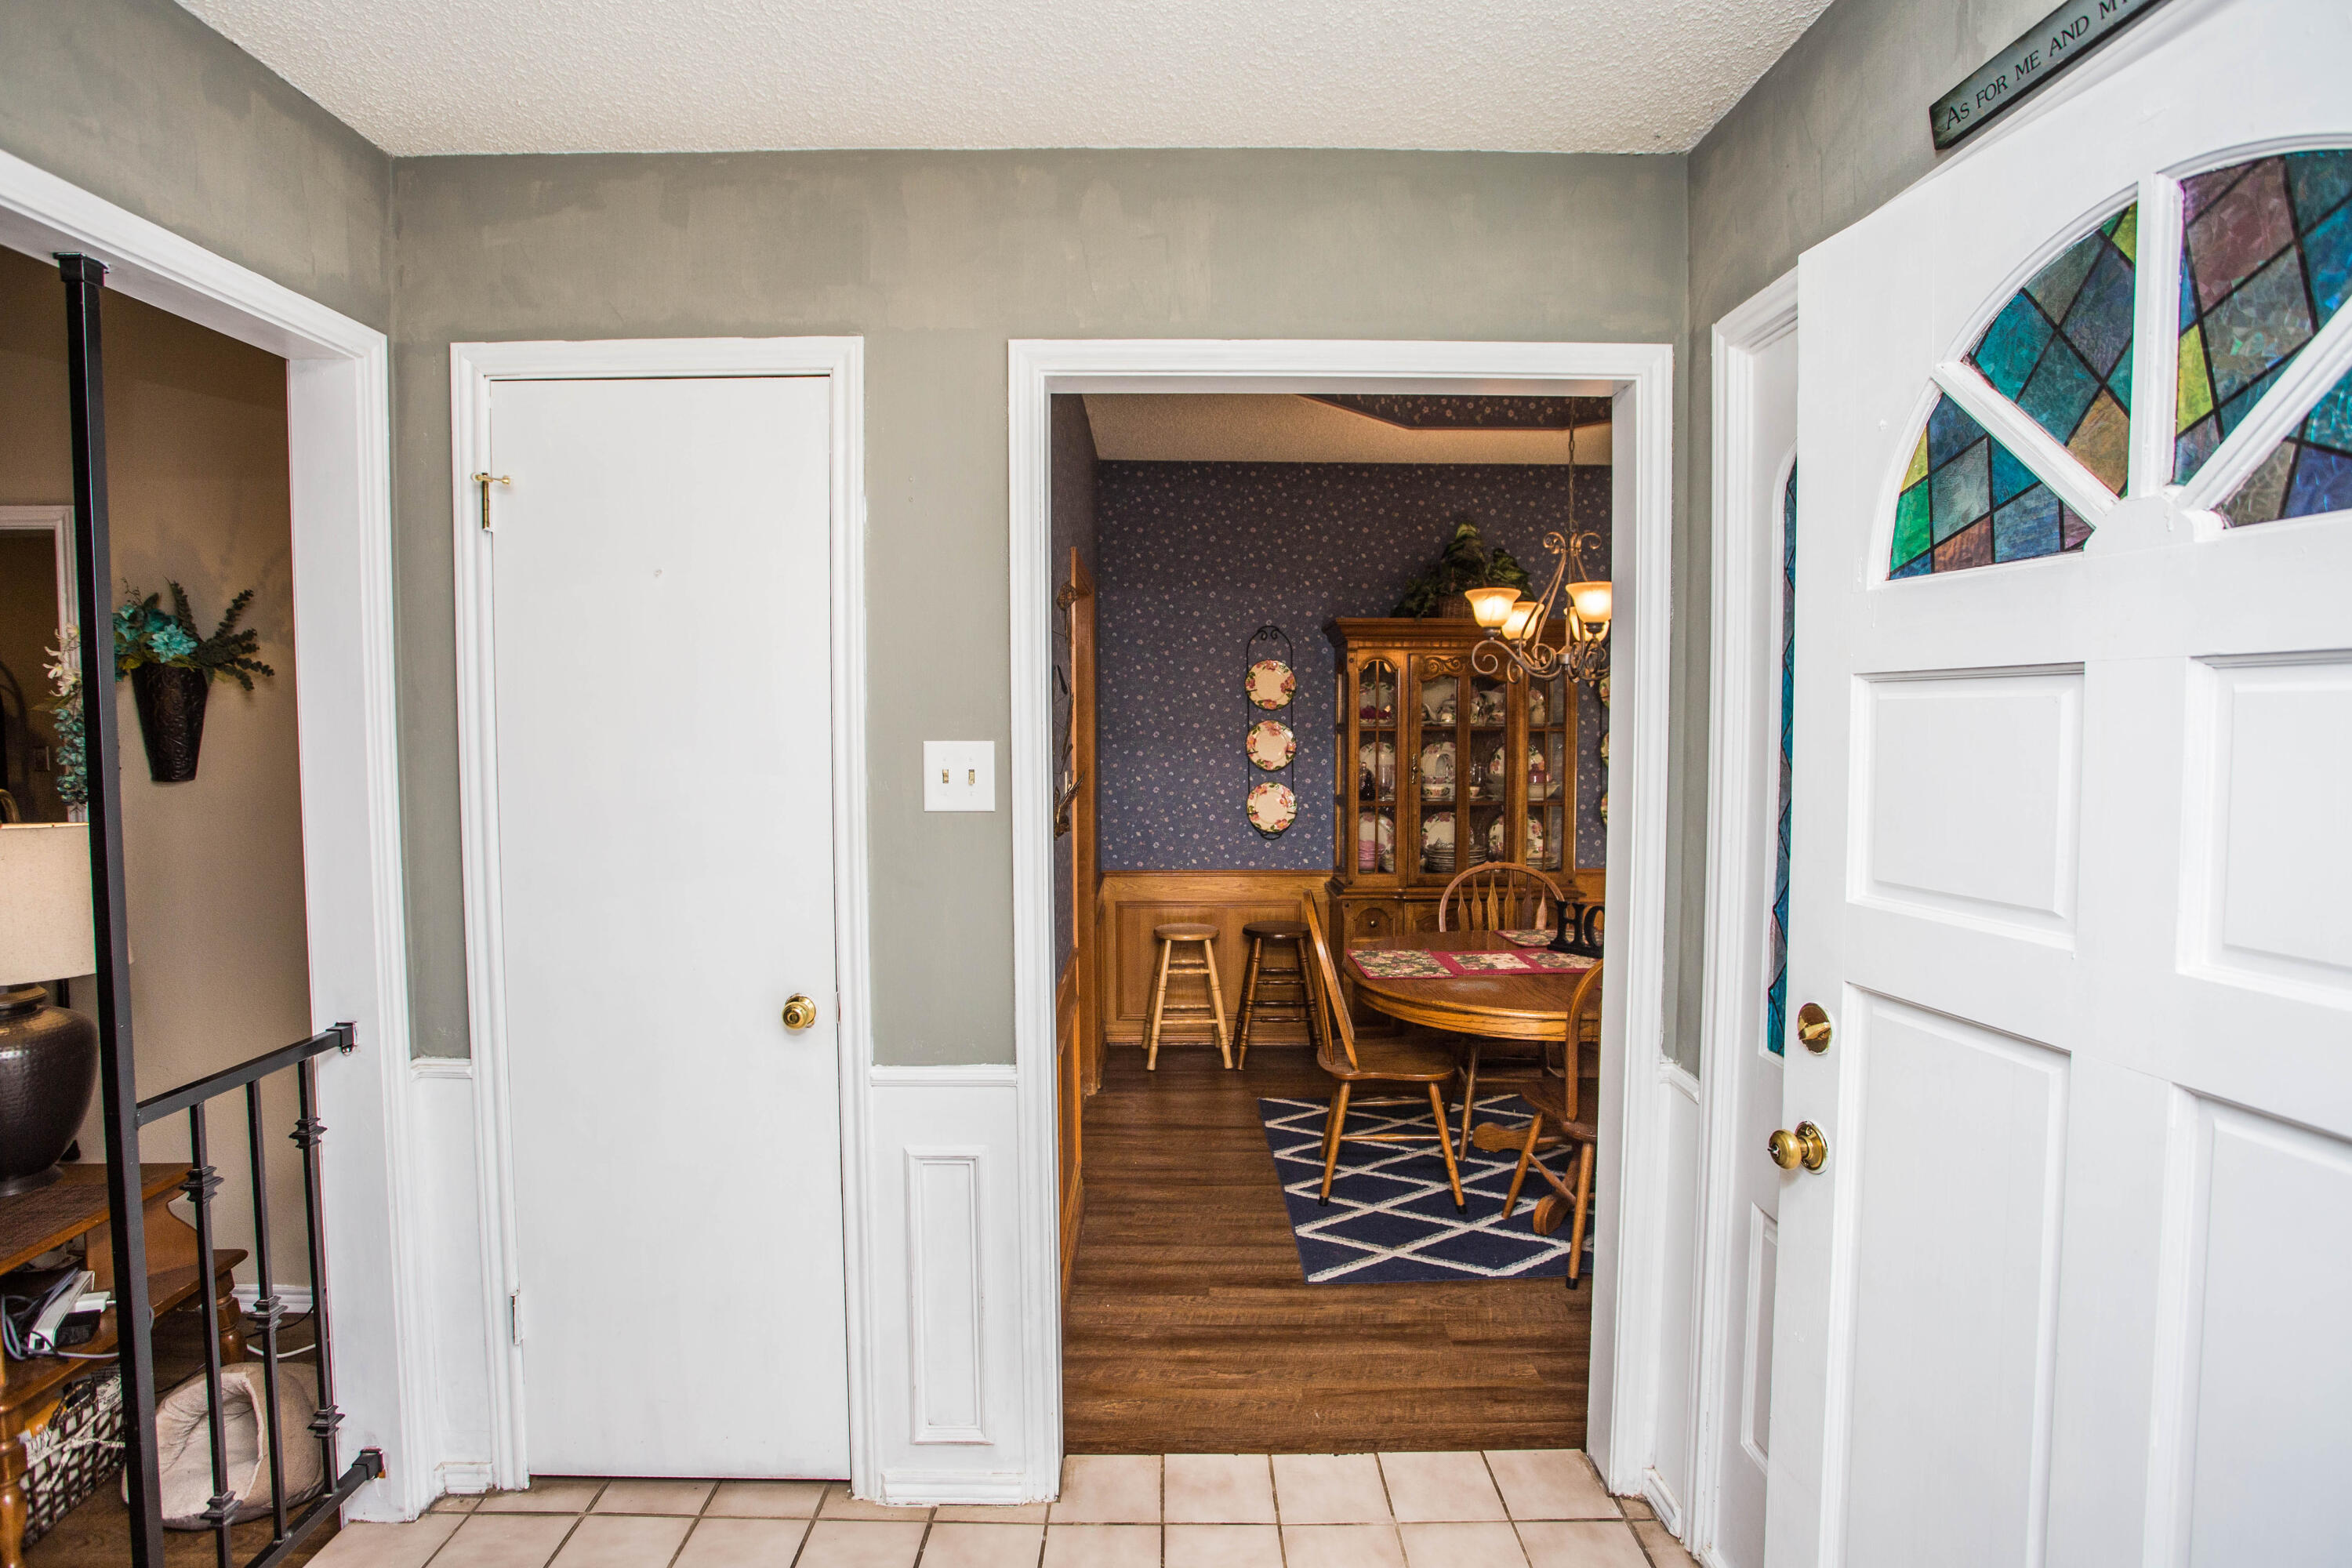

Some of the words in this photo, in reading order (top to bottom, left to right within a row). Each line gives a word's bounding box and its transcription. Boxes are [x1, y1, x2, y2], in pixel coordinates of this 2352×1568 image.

[1975, 74, 2009, 108] FOR
[2014, 49, 2042, 81] ME
[2048, 15, 2090, 56] AND
[2098, 0, 2127, 20] M
